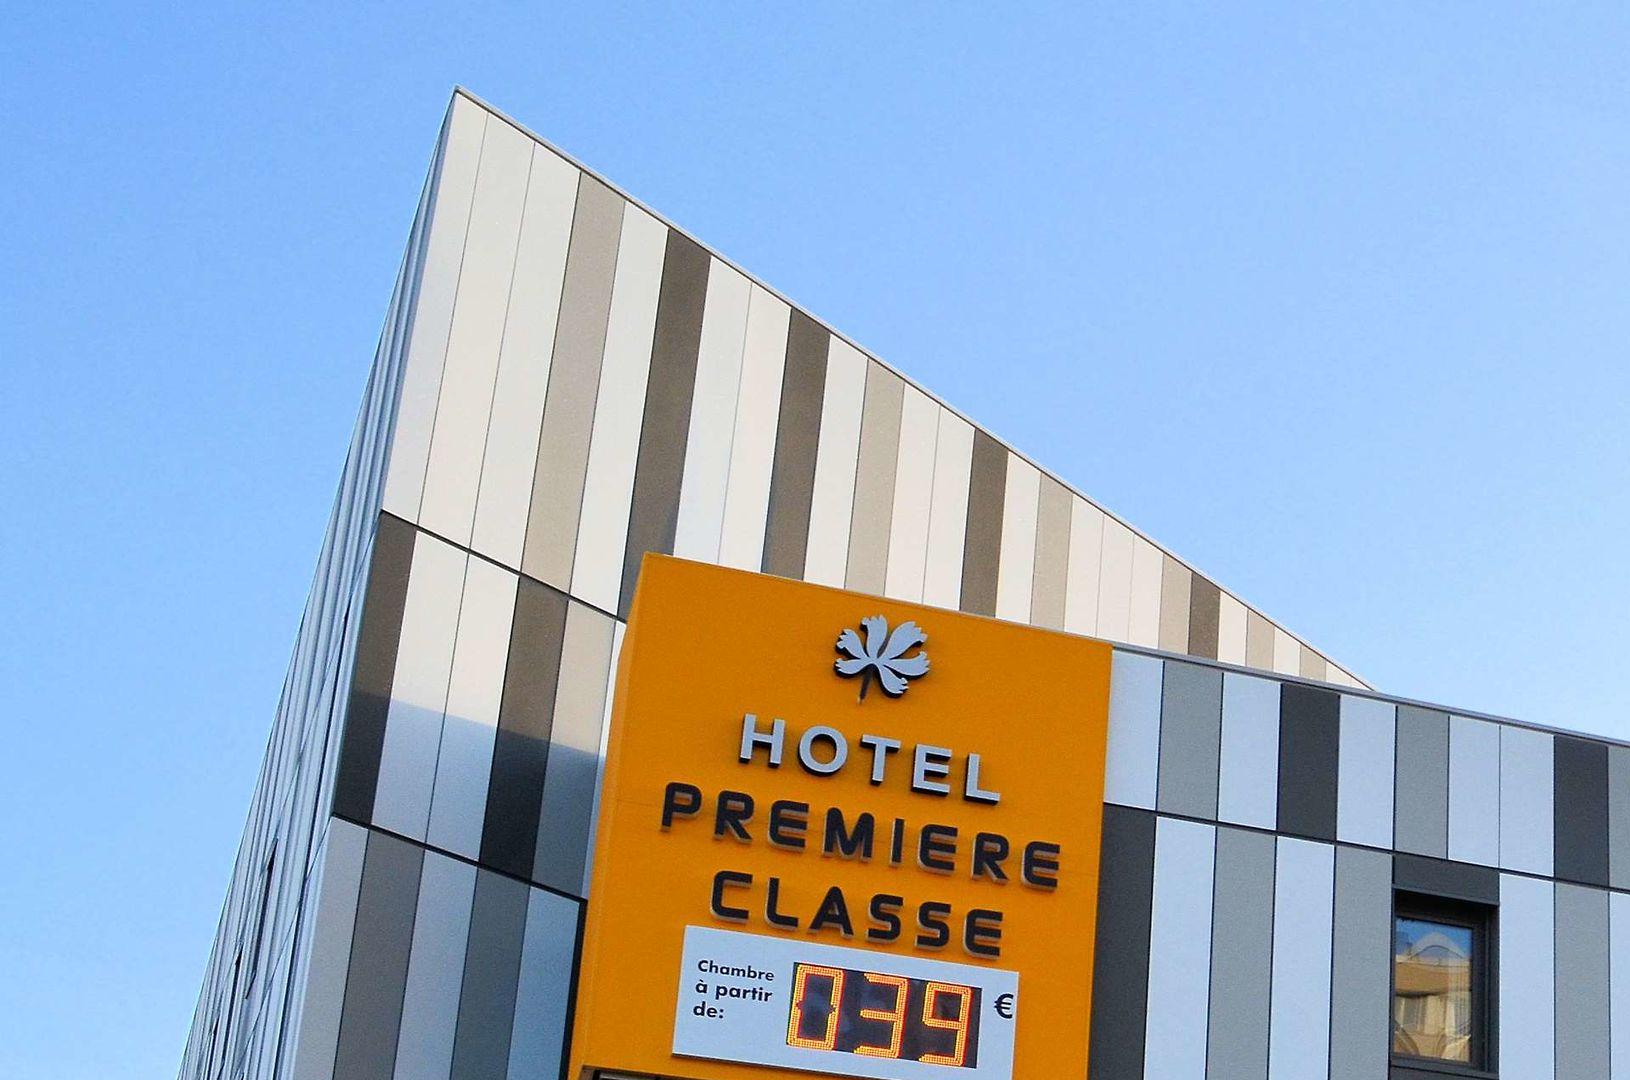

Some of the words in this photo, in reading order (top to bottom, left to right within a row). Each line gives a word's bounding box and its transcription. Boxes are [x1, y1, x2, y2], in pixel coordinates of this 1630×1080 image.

[739, 713, 1001, 806] HOTEL
[661, 781, 1062, 891] PREMIERE
[709, 870, 1004, 959] CLASSE
[695, 979, 708, 995] à
[715, 982, 773, 1003] partir
[697, 960, 775, 982] Chambre
[693, 1000, 724, 1019] de:
[786, 963, 972, 1067] 039
[994, 993, 1014, 1019] €
